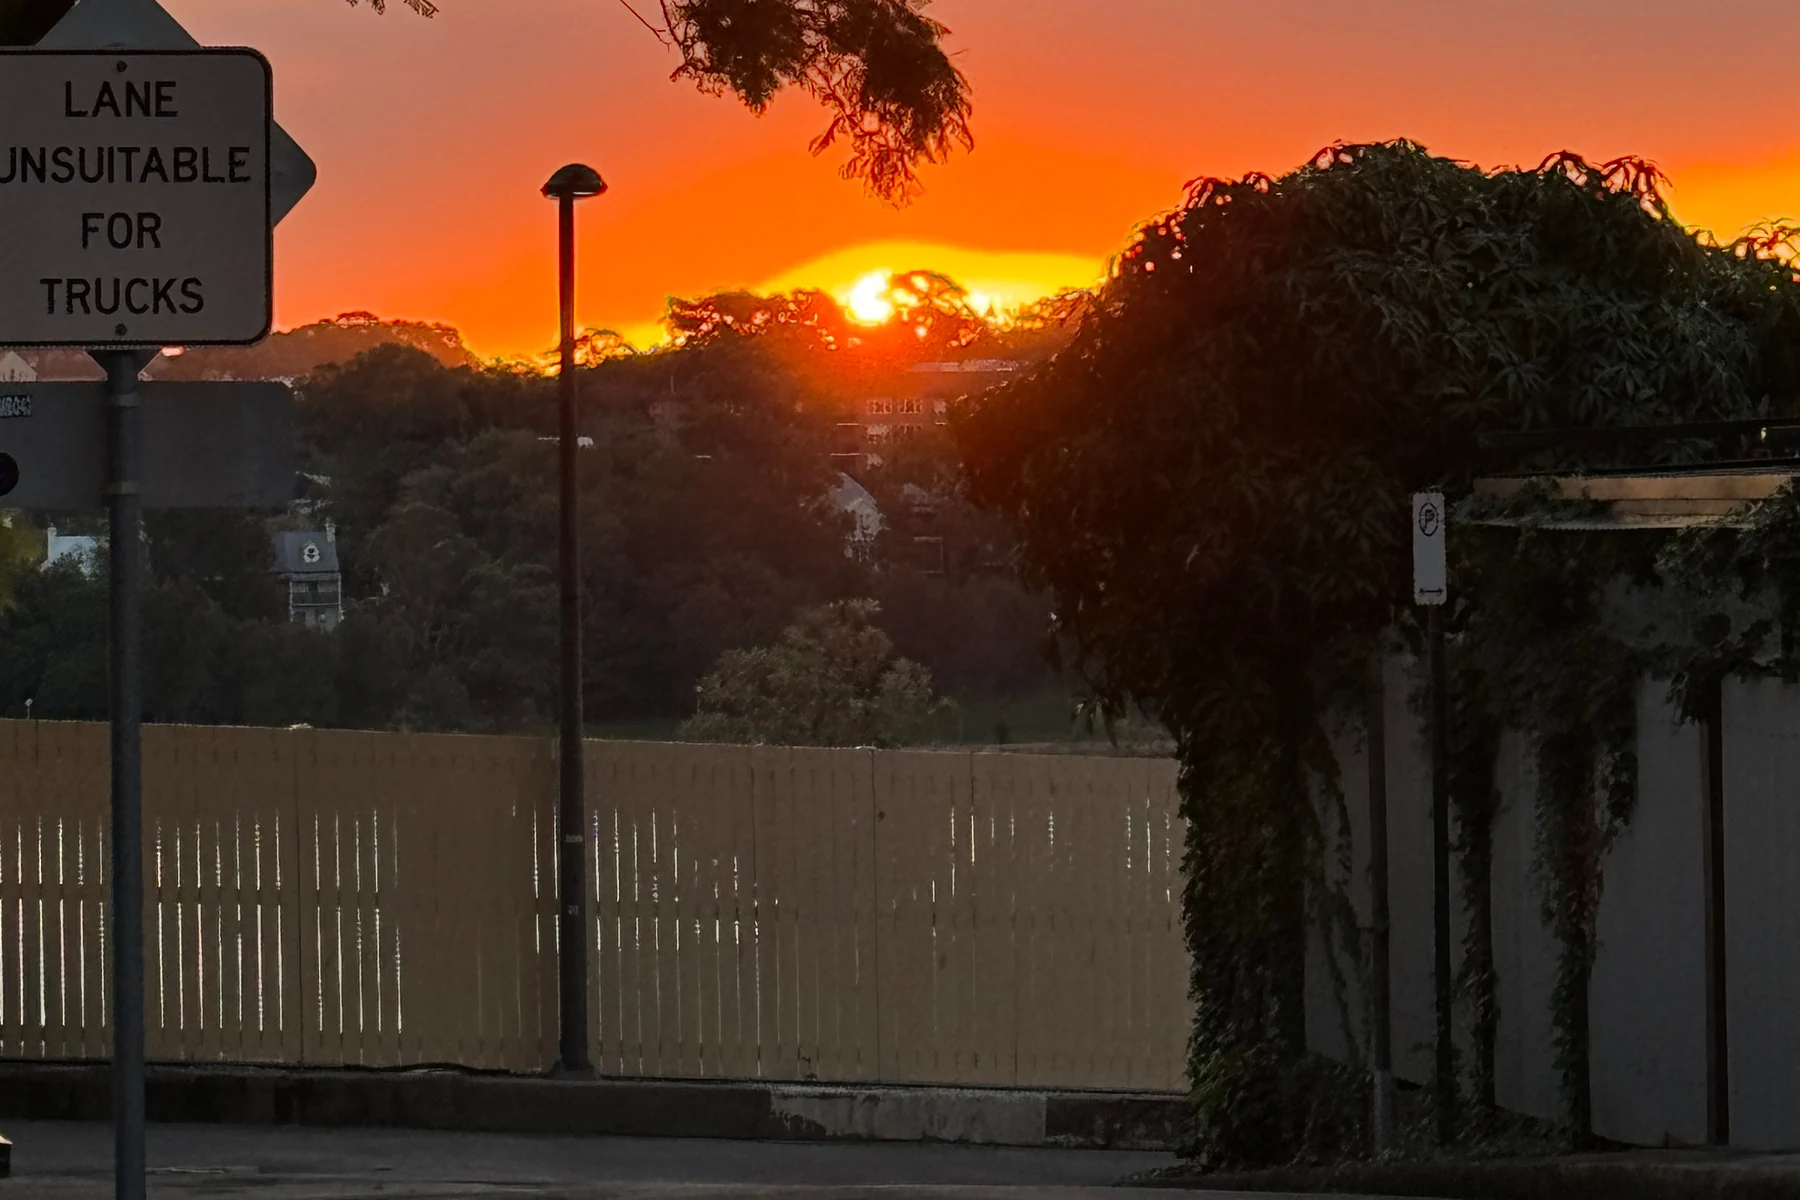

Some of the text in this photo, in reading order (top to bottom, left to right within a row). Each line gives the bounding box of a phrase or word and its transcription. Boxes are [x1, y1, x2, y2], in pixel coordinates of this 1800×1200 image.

[65, 81, 178, 117] LANE
[0, 146, 251, 184] UNSUITABLE
[82, 212, 161, 249] FOR
[40, 277, 204, 315] TRUCKS
